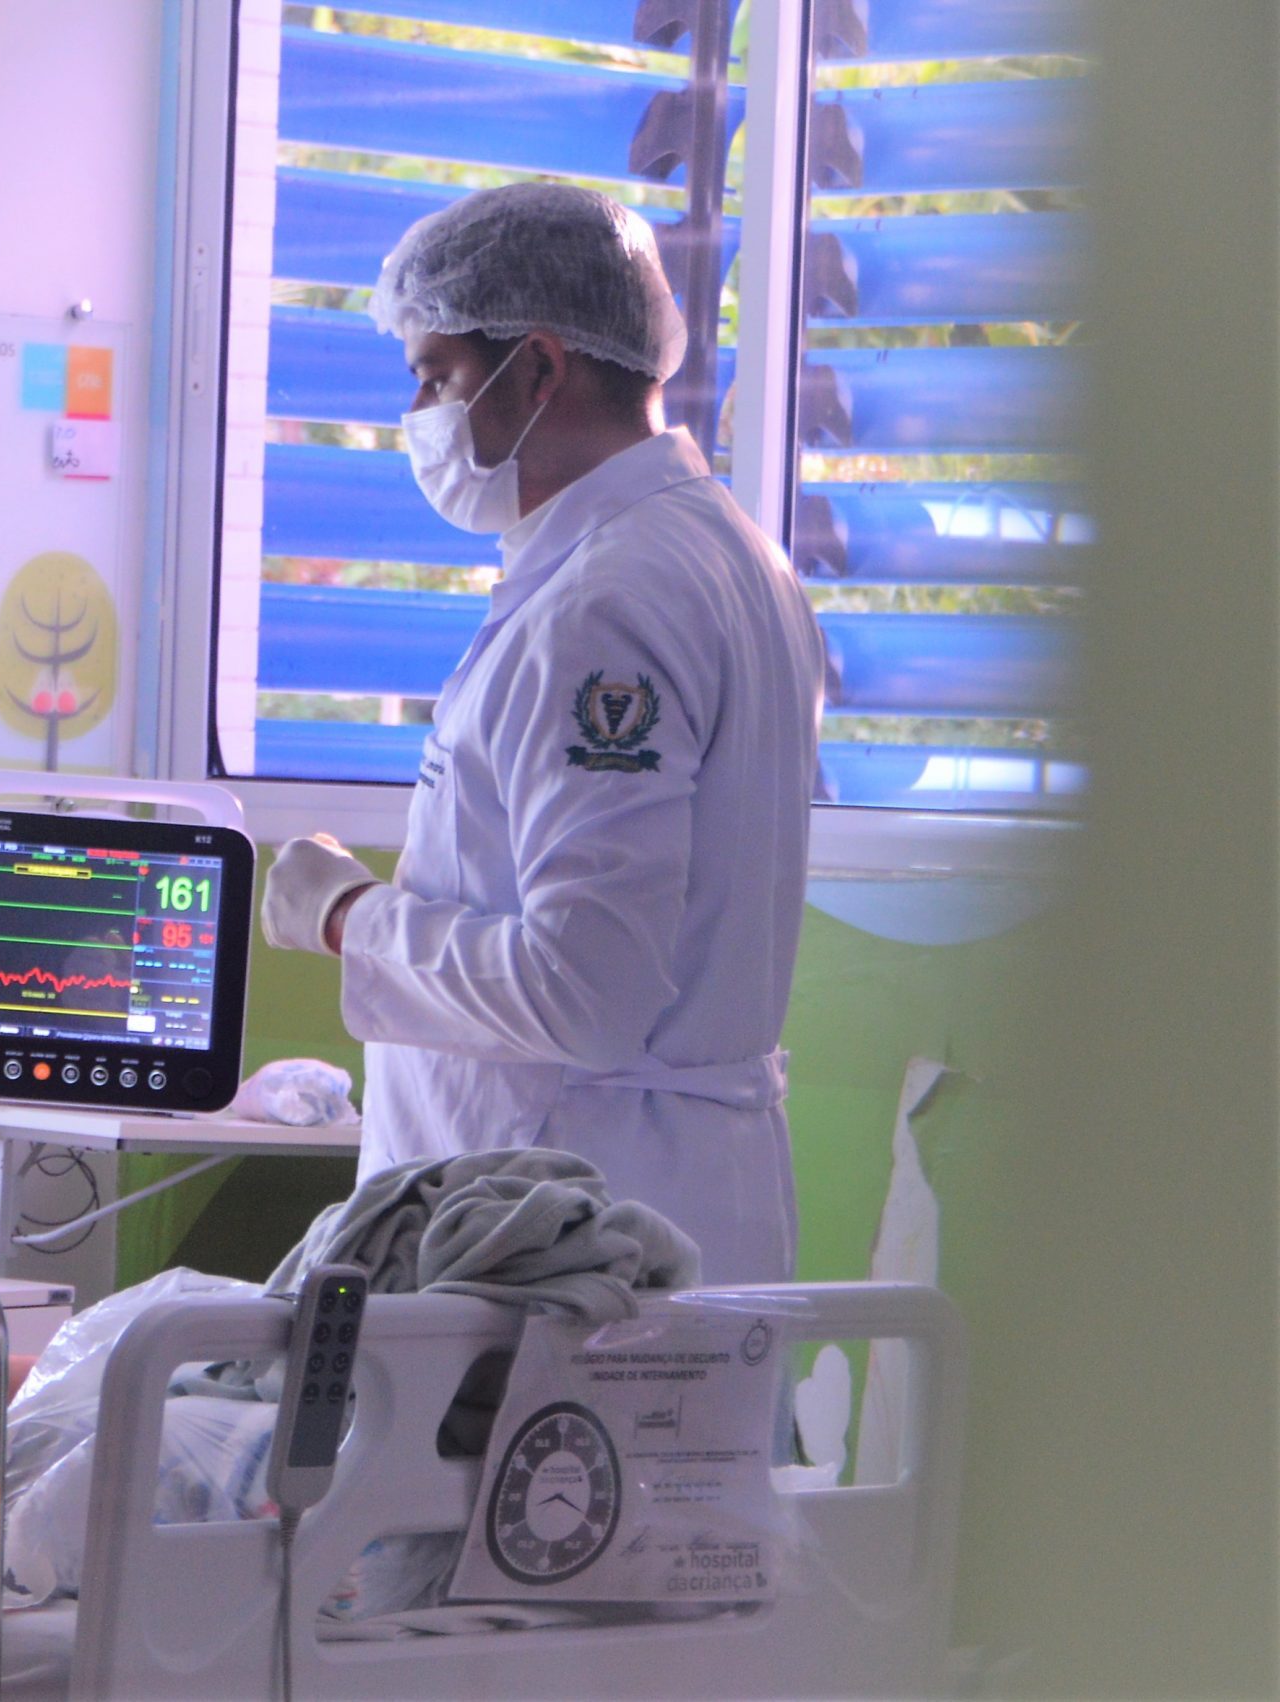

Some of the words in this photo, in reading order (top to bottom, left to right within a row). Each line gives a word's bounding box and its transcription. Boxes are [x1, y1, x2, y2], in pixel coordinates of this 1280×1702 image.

[155, 874, 210, 912] 161
[162, 920, 193, 948] 95
[690, 1550, 759, 1570] hospital
